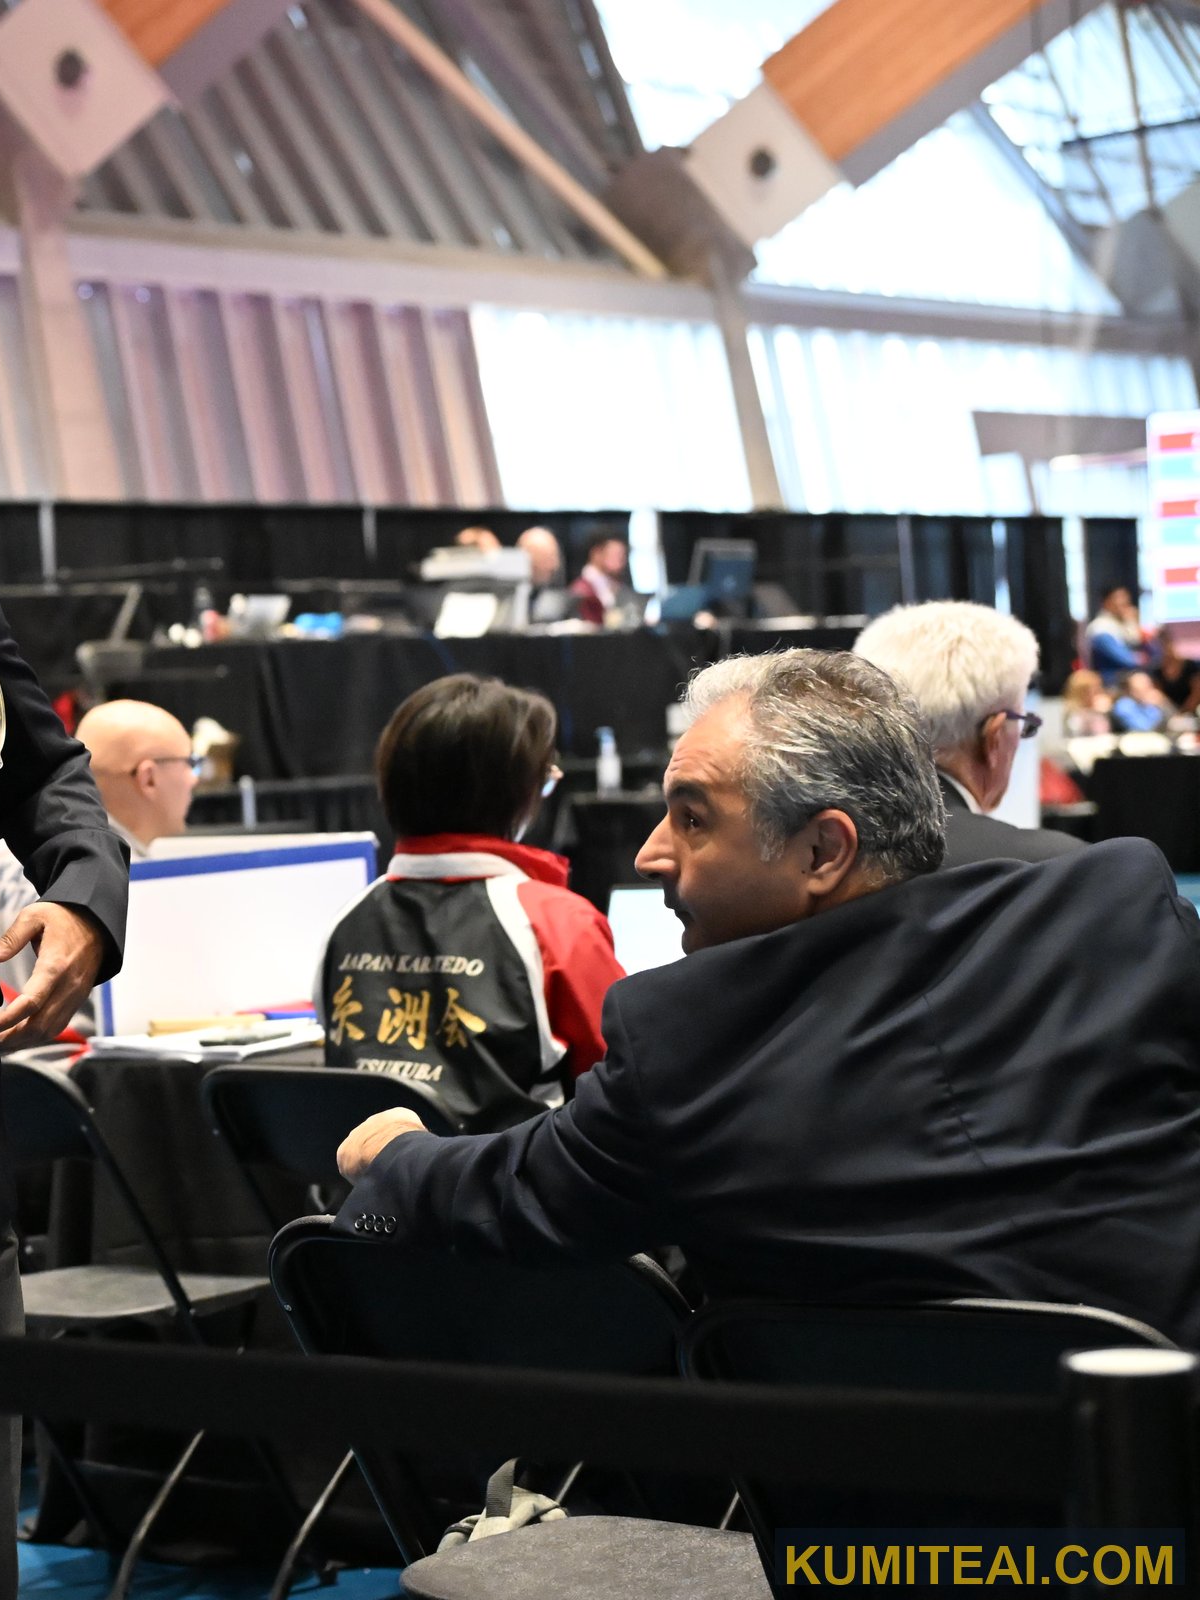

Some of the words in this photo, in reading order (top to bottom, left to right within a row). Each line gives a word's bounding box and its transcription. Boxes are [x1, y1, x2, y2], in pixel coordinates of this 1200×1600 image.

[338, 953, 394, 972] JAPAN
[396, 954, 485, 976] KARTEDO
[355, 1057, 443, 1081] TSUKUBA
